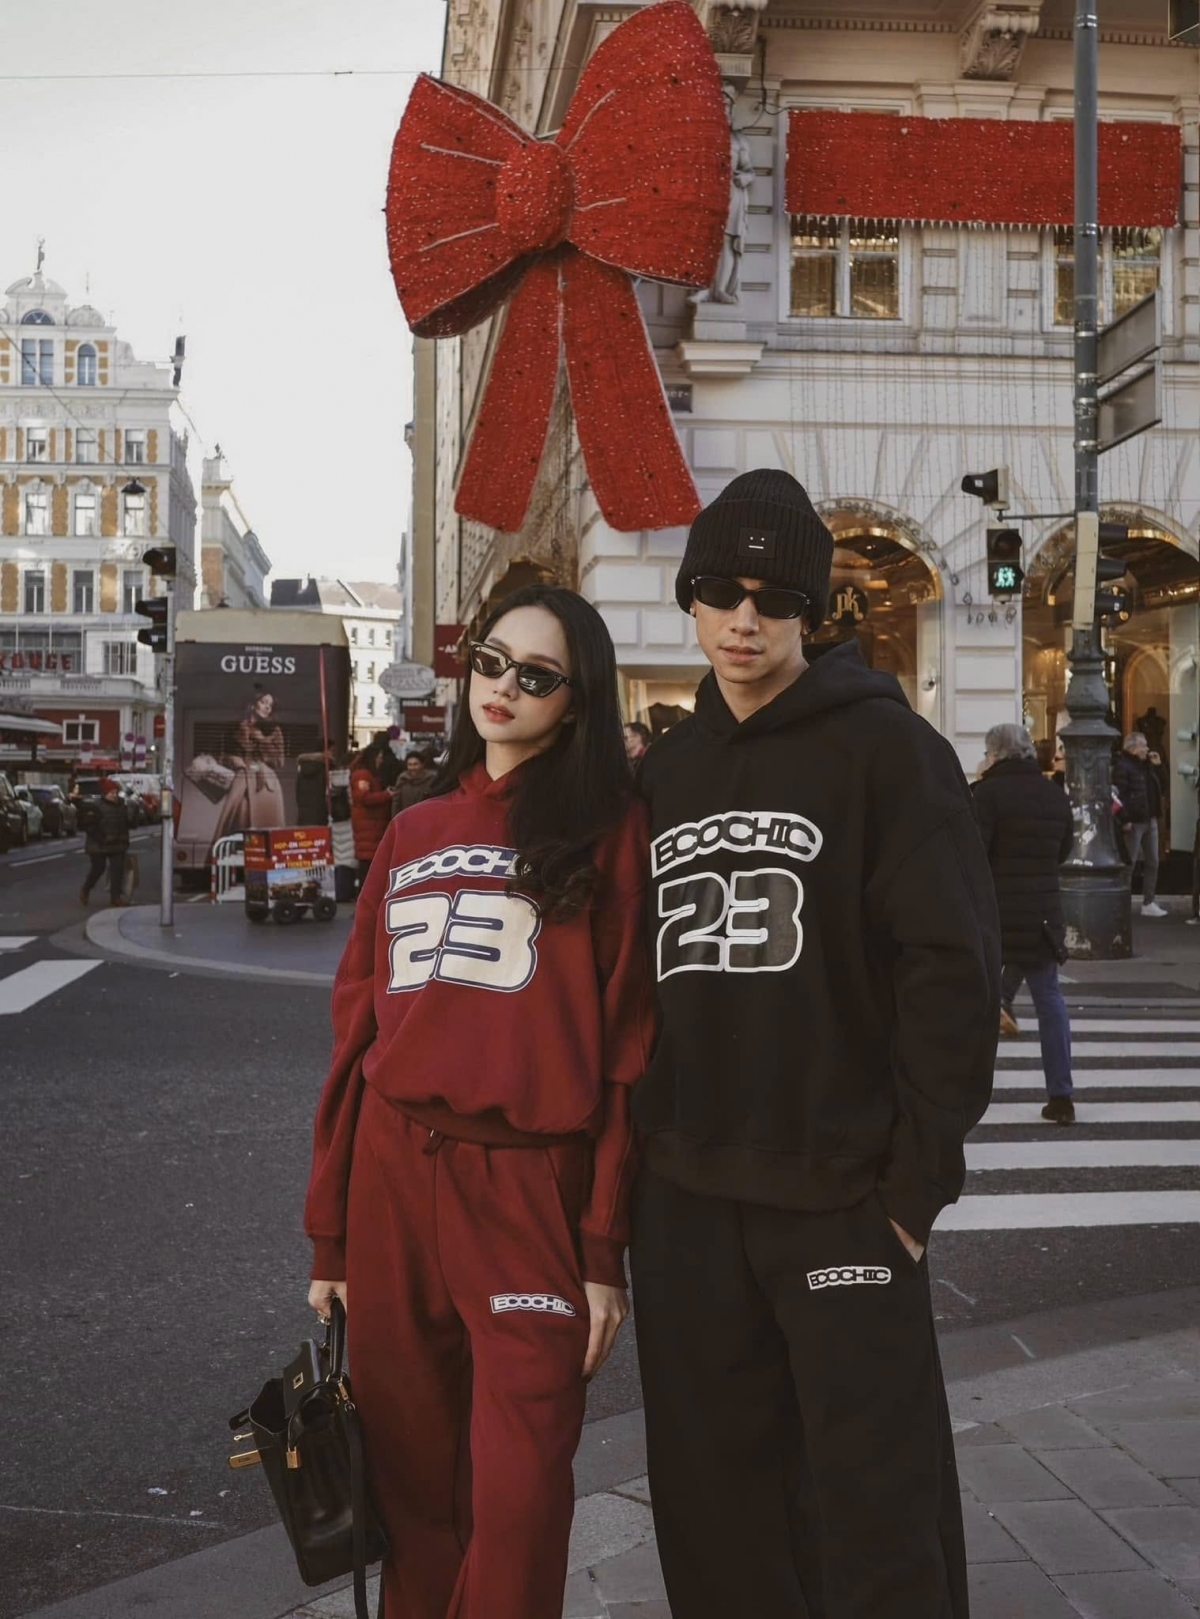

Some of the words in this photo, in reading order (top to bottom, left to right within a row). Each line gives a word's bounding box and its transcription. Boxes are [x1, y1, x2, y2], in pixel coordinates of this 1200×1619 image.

[220, 655, 296, 674] GUESS
[652, 811, 823, 877] ECOCHIC
[386, 845, 530, 897] ECOCH
[386, 889, 541, 993] 23
[657, 867, 803, 982] 23
[806, 1265, 892, 1290] ECOCHIC
[490, 1293, 576, 1317] ECOCHIC
